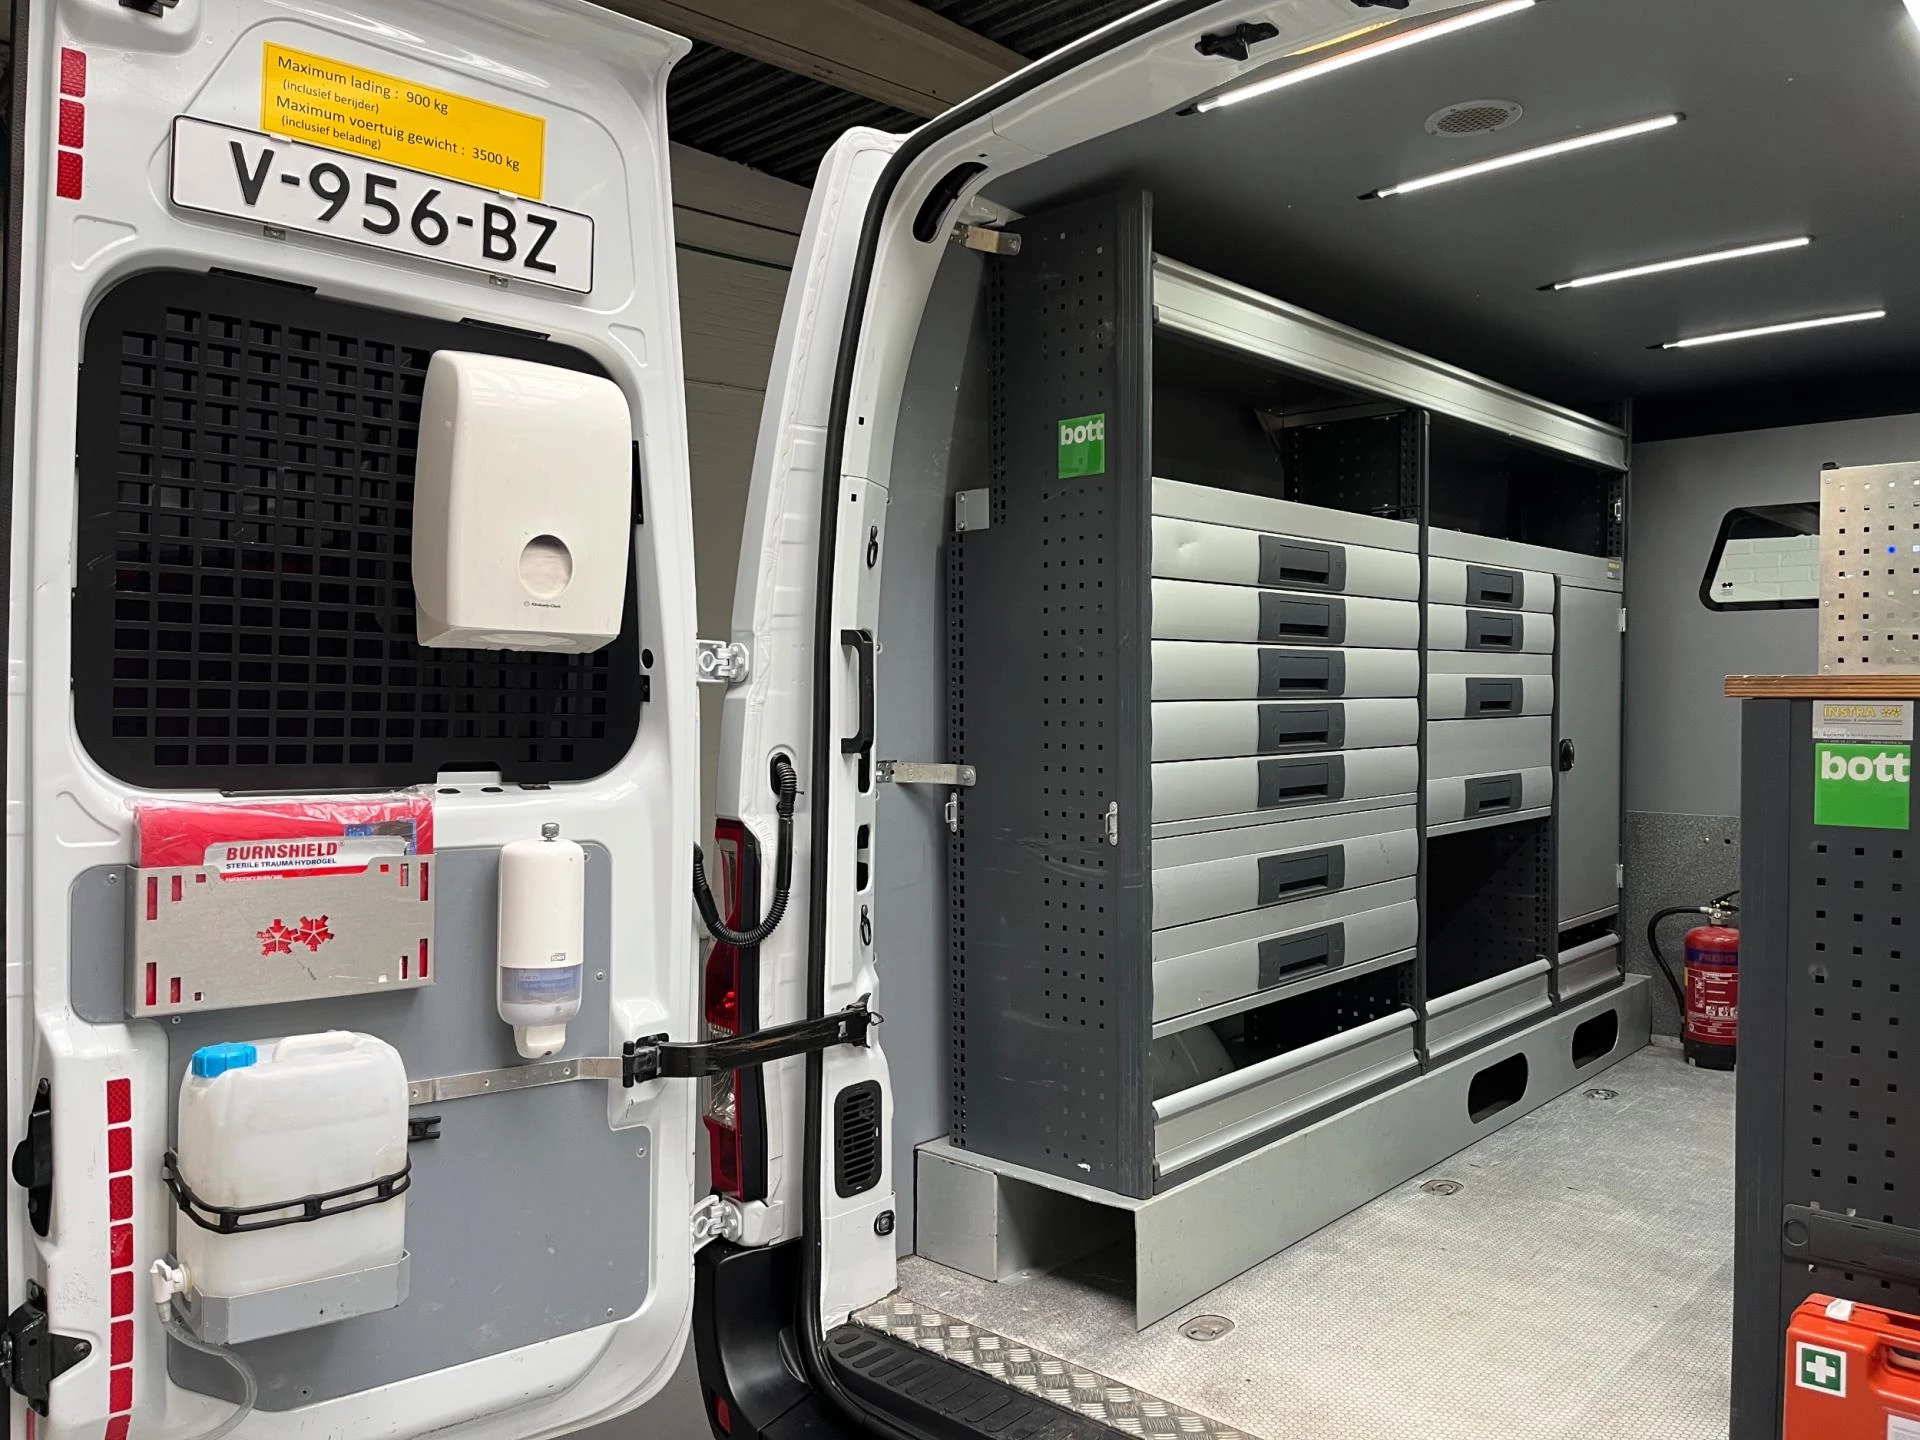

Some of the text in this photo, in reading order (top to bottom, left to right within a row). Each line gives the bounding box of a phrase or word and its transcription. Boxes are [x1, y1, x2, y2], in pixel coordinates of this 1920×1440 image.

[278, 55, 347, 87] Maximum
[350, 73, 391, 100] lading
[406, 90, 430, 109] 900
[434, 96, 449, 116] kg
[283, 79, 380, 115] (inclusief berijder)
[276, 95, 346, 124] Maximum
[349, 117, 405, 143] voertuig
[408, 129, 458, 155] gewicht
[471, 147, 503, 166] 3500
[505, 157, 520, 172] kg
[281, 115, 381, 151] (inclusief belading)
[229, 140, 558, 273] V-956-BZ
[1061, 420, 1104, 446] bott
[1824, 707, 1875, 717] INSTRA
[1821, 751, 1910, 783] bott
[226, 842, 338, 861] BURNSHIELD
[226, 858, 336, 870] STERILE TRAUMA HYDROGEL
